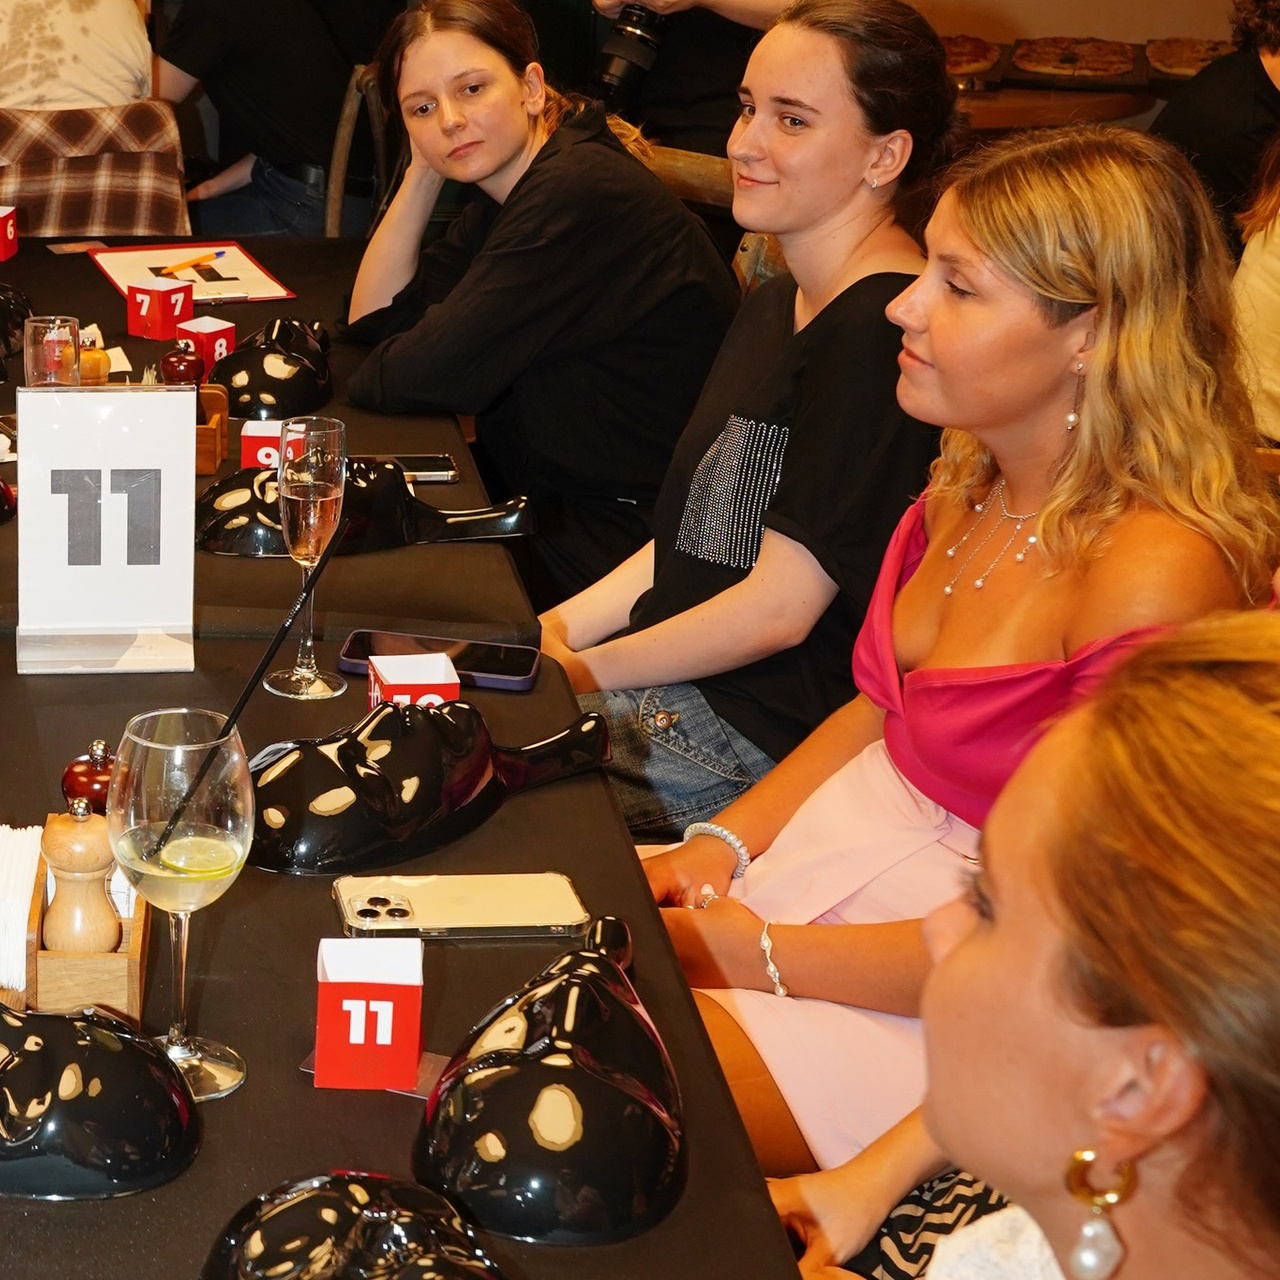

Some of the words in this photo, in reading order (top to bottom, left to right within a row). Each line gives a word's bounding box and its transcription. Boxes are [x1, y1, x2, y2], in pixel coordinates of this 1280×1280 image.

[7, 219, 15, 240] 6
[136, 293, 151, 316] 7
[171, 292, 185, 316] 7
[214, 338, 227, 362] 8
[256, 446, 280, 469] 9
[50, 468, 162, 566] 11
[342, 999, 394, 1045] 11
